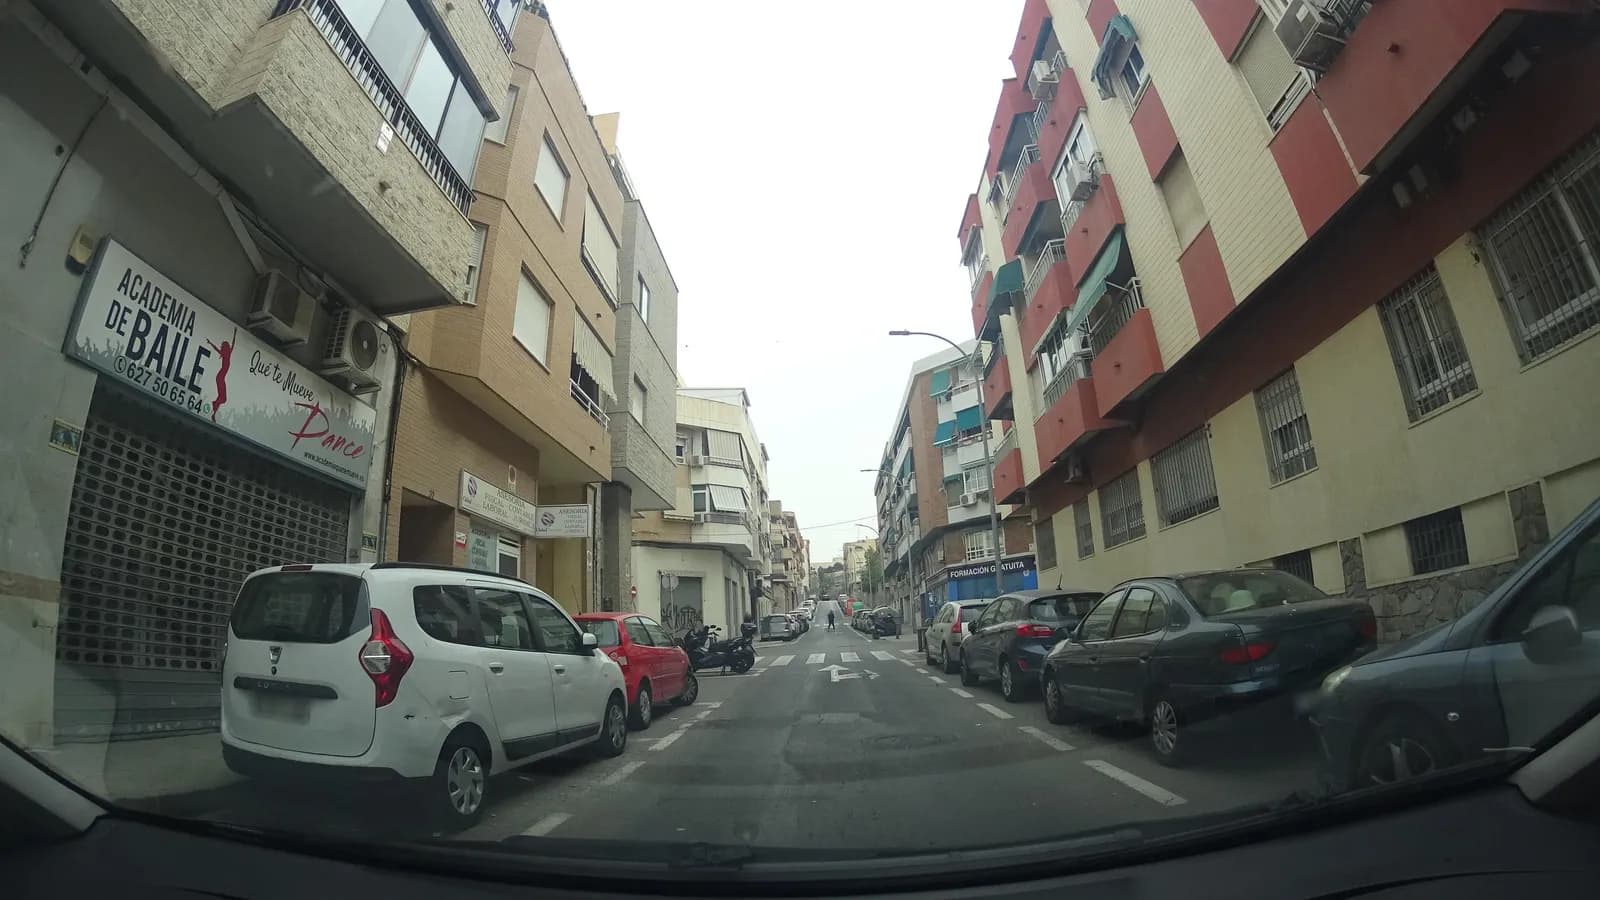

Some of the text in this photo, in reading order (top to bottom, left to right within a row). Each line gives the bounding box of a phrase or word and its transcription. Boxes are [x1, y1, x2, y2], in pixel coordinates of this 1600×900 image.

[117, 268, 196, 336] ACADEMIA
[104, 300, 211, 395] DE BAILE
[127, 362, 203, 413] 627 50 65 64
[249, 350, 314, 402] Qué te Mueve
[288, 401, 364, 459] Dance
[950, 561, 1024, 578] FORMACIÓN GATUITA
